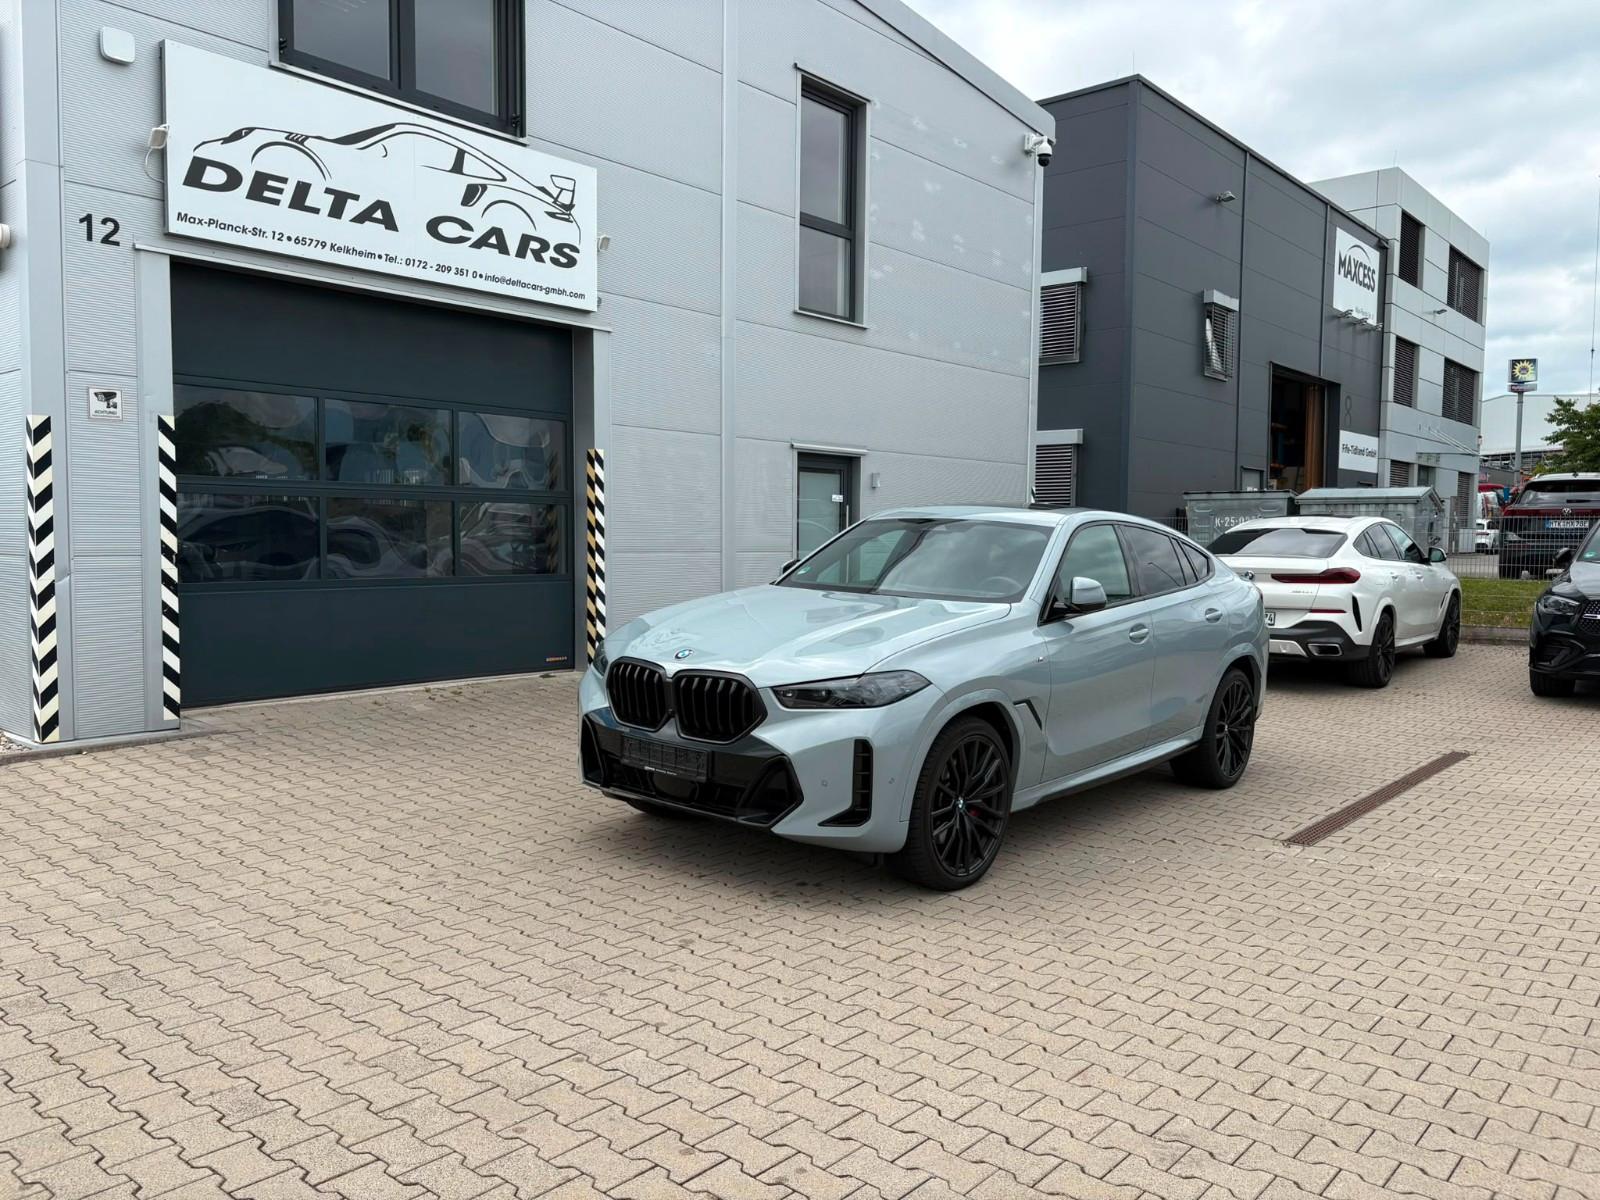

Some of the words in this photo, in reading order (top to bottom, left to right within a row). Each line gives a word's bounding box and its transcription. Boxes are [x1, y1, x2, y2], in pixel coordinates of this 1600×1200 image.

[79, 213, 120, 247] 12
[182, 155, 399, 233] DELTA
[425, 215, 580, 269] CARS
[176, 211, 268, 239] Max-Planck-Str.
[329, 242, 377, 260] Kelkheim
[405, 257, 428, 270] 0172
[435, 262, 452, 274] 209
[454, 266, 469, 278] 351
[484, 272, 586, 300] info@deltacars-gmbh.com
[1337, 251, 1376, 293] MAXCESS
